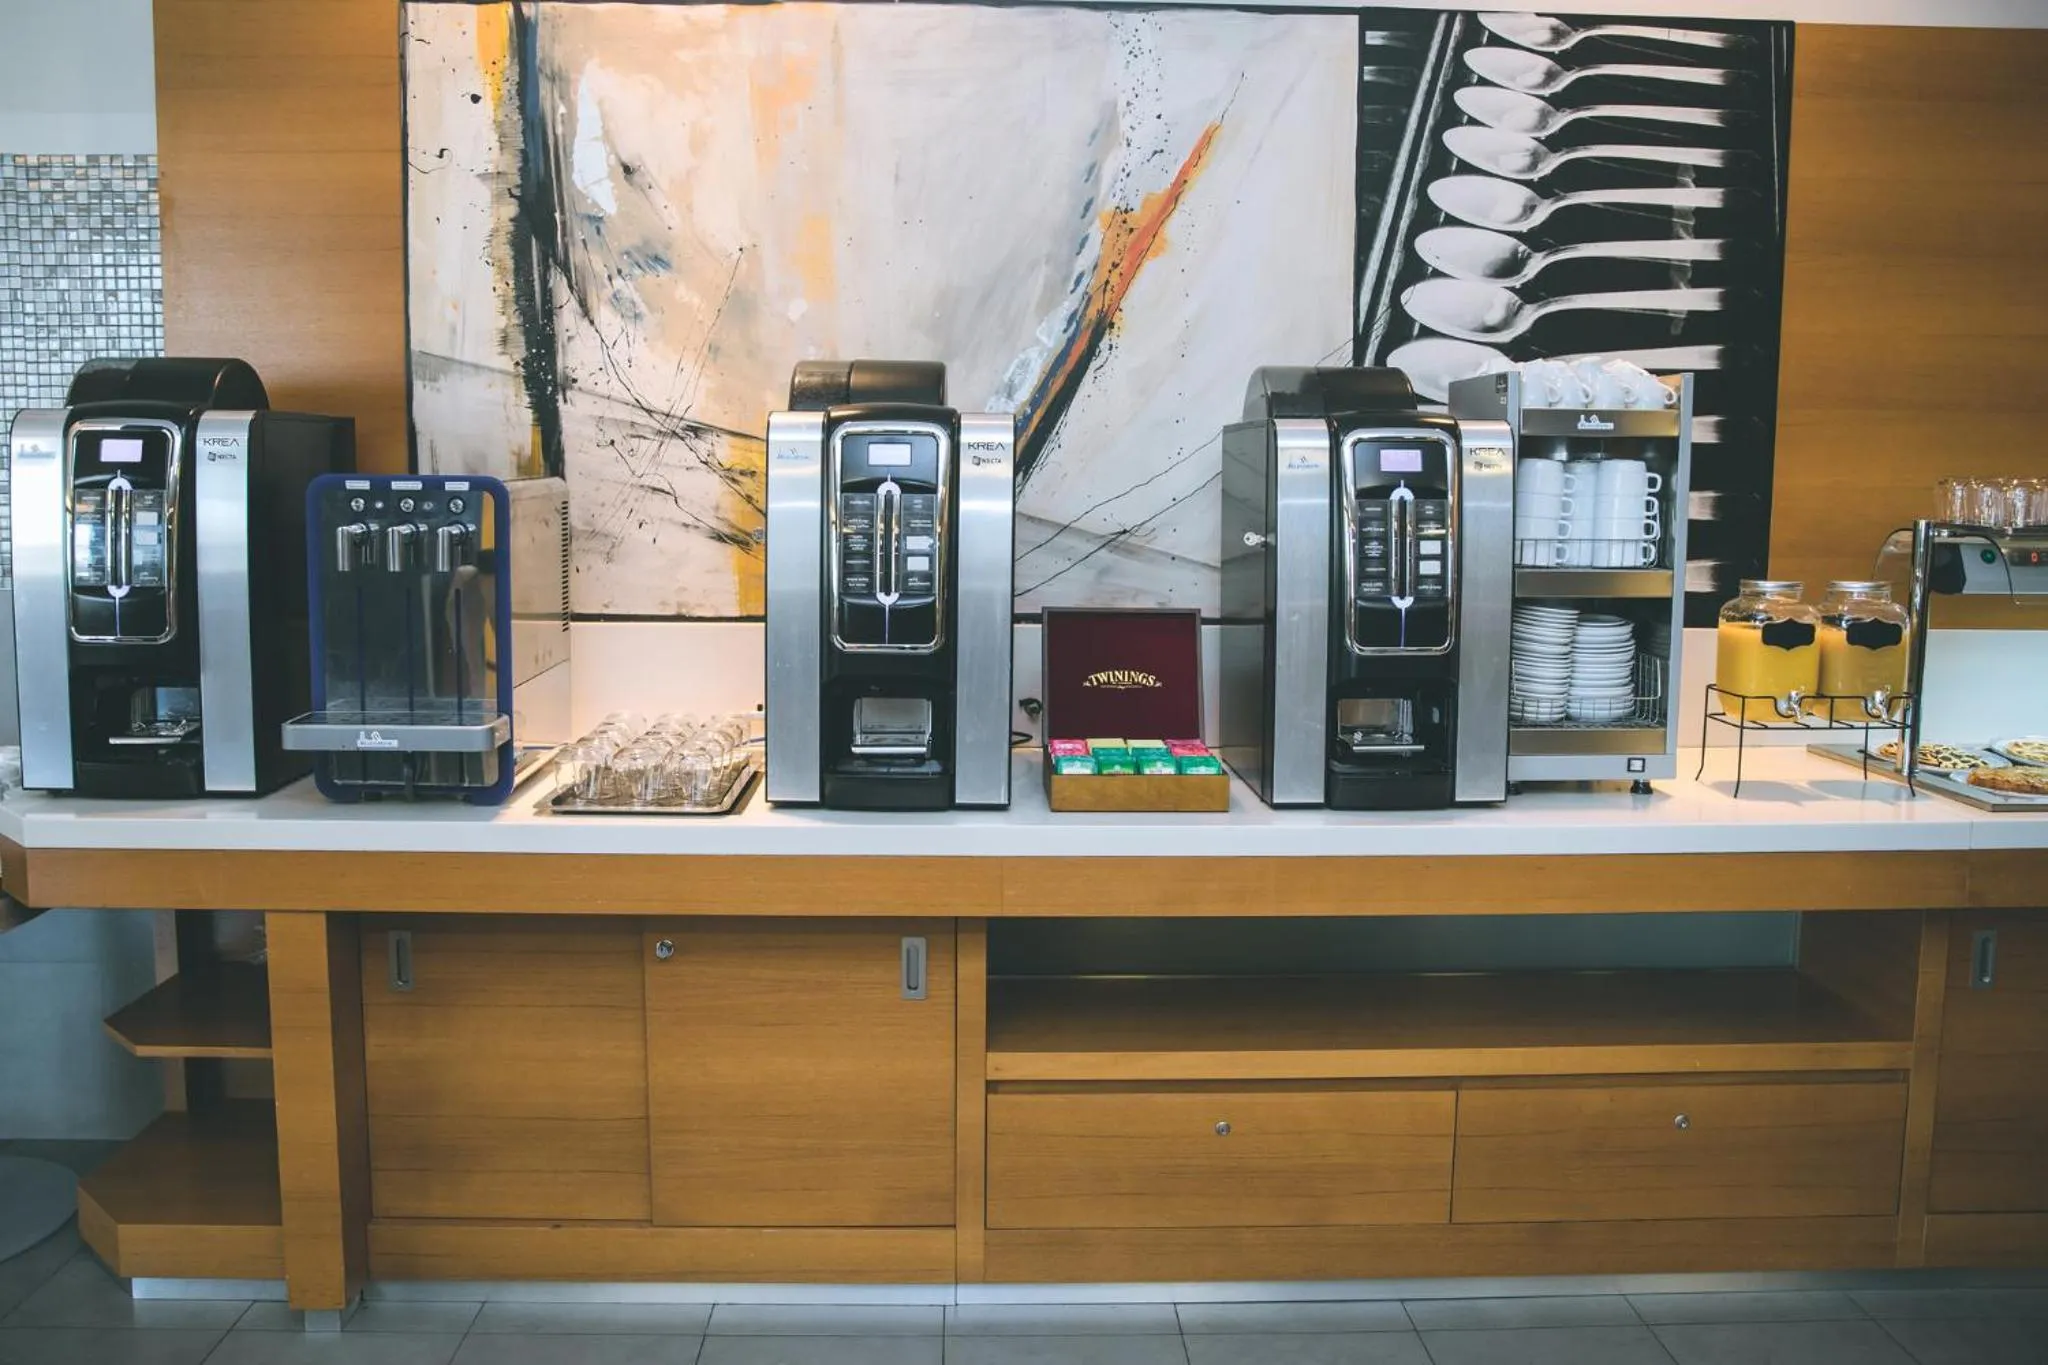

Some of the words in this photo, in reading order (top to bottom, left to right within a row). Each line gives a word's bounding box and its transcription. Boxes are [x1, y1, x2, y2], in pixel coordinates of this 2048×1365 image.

[203, 437, 240, 447] KREA
[967, 441, 1006, 451] KREA
[1087, 669, 1157, 687] TWININGS
